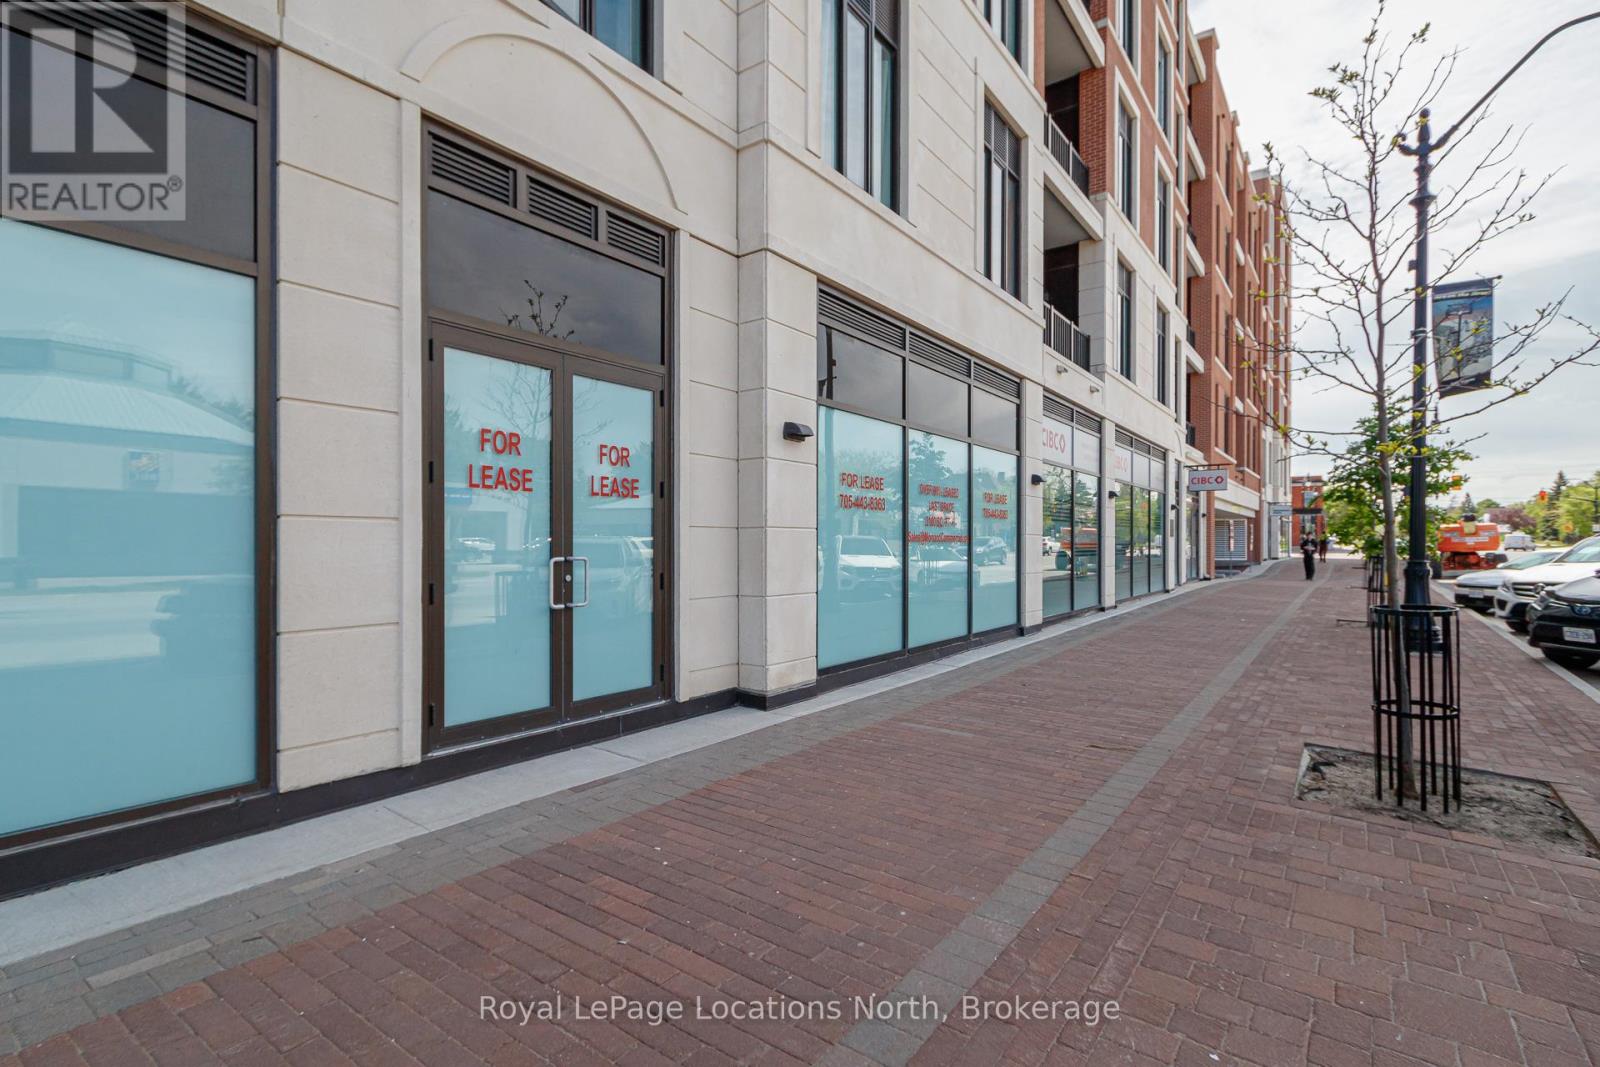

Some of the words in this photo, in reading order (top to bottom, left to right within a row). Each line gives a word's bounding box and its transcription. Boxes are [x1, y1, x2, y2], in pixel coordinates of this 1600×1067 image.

[480, 428, 521, 456] FOR
[599, 444, 631, 467] FOR
[468, 464, 533, 492] LEASE
[591, 475, 639, 499] LEASE
[841, 472, 858, 488] FOR
[861, 475, 884, 491] LEASE
[1191, 476, 1215, 485] CIBC
